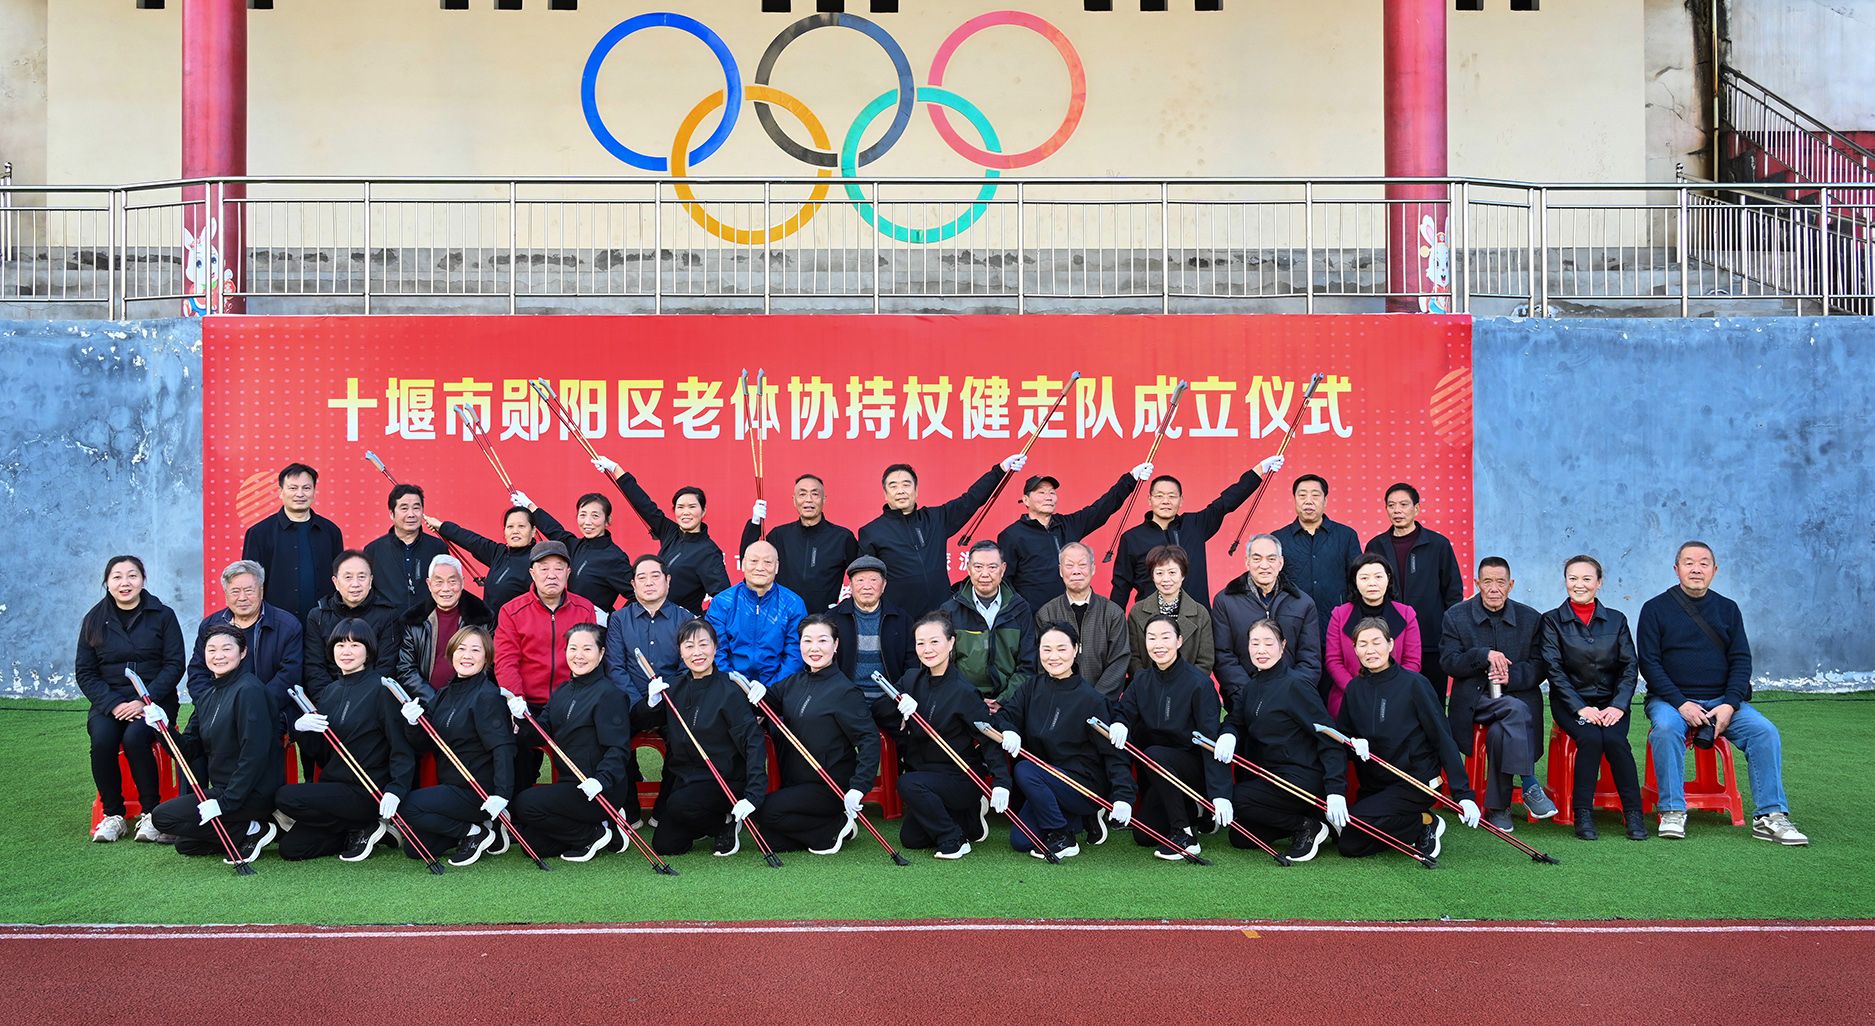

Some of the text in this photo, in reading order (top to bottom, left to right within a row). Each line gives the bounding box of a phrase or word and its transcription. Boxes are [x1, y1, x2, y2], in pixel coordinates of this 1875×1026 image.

[327, 375, 1353, 441] 十堰市郧阳区老体协持杖健走队成立仪式
